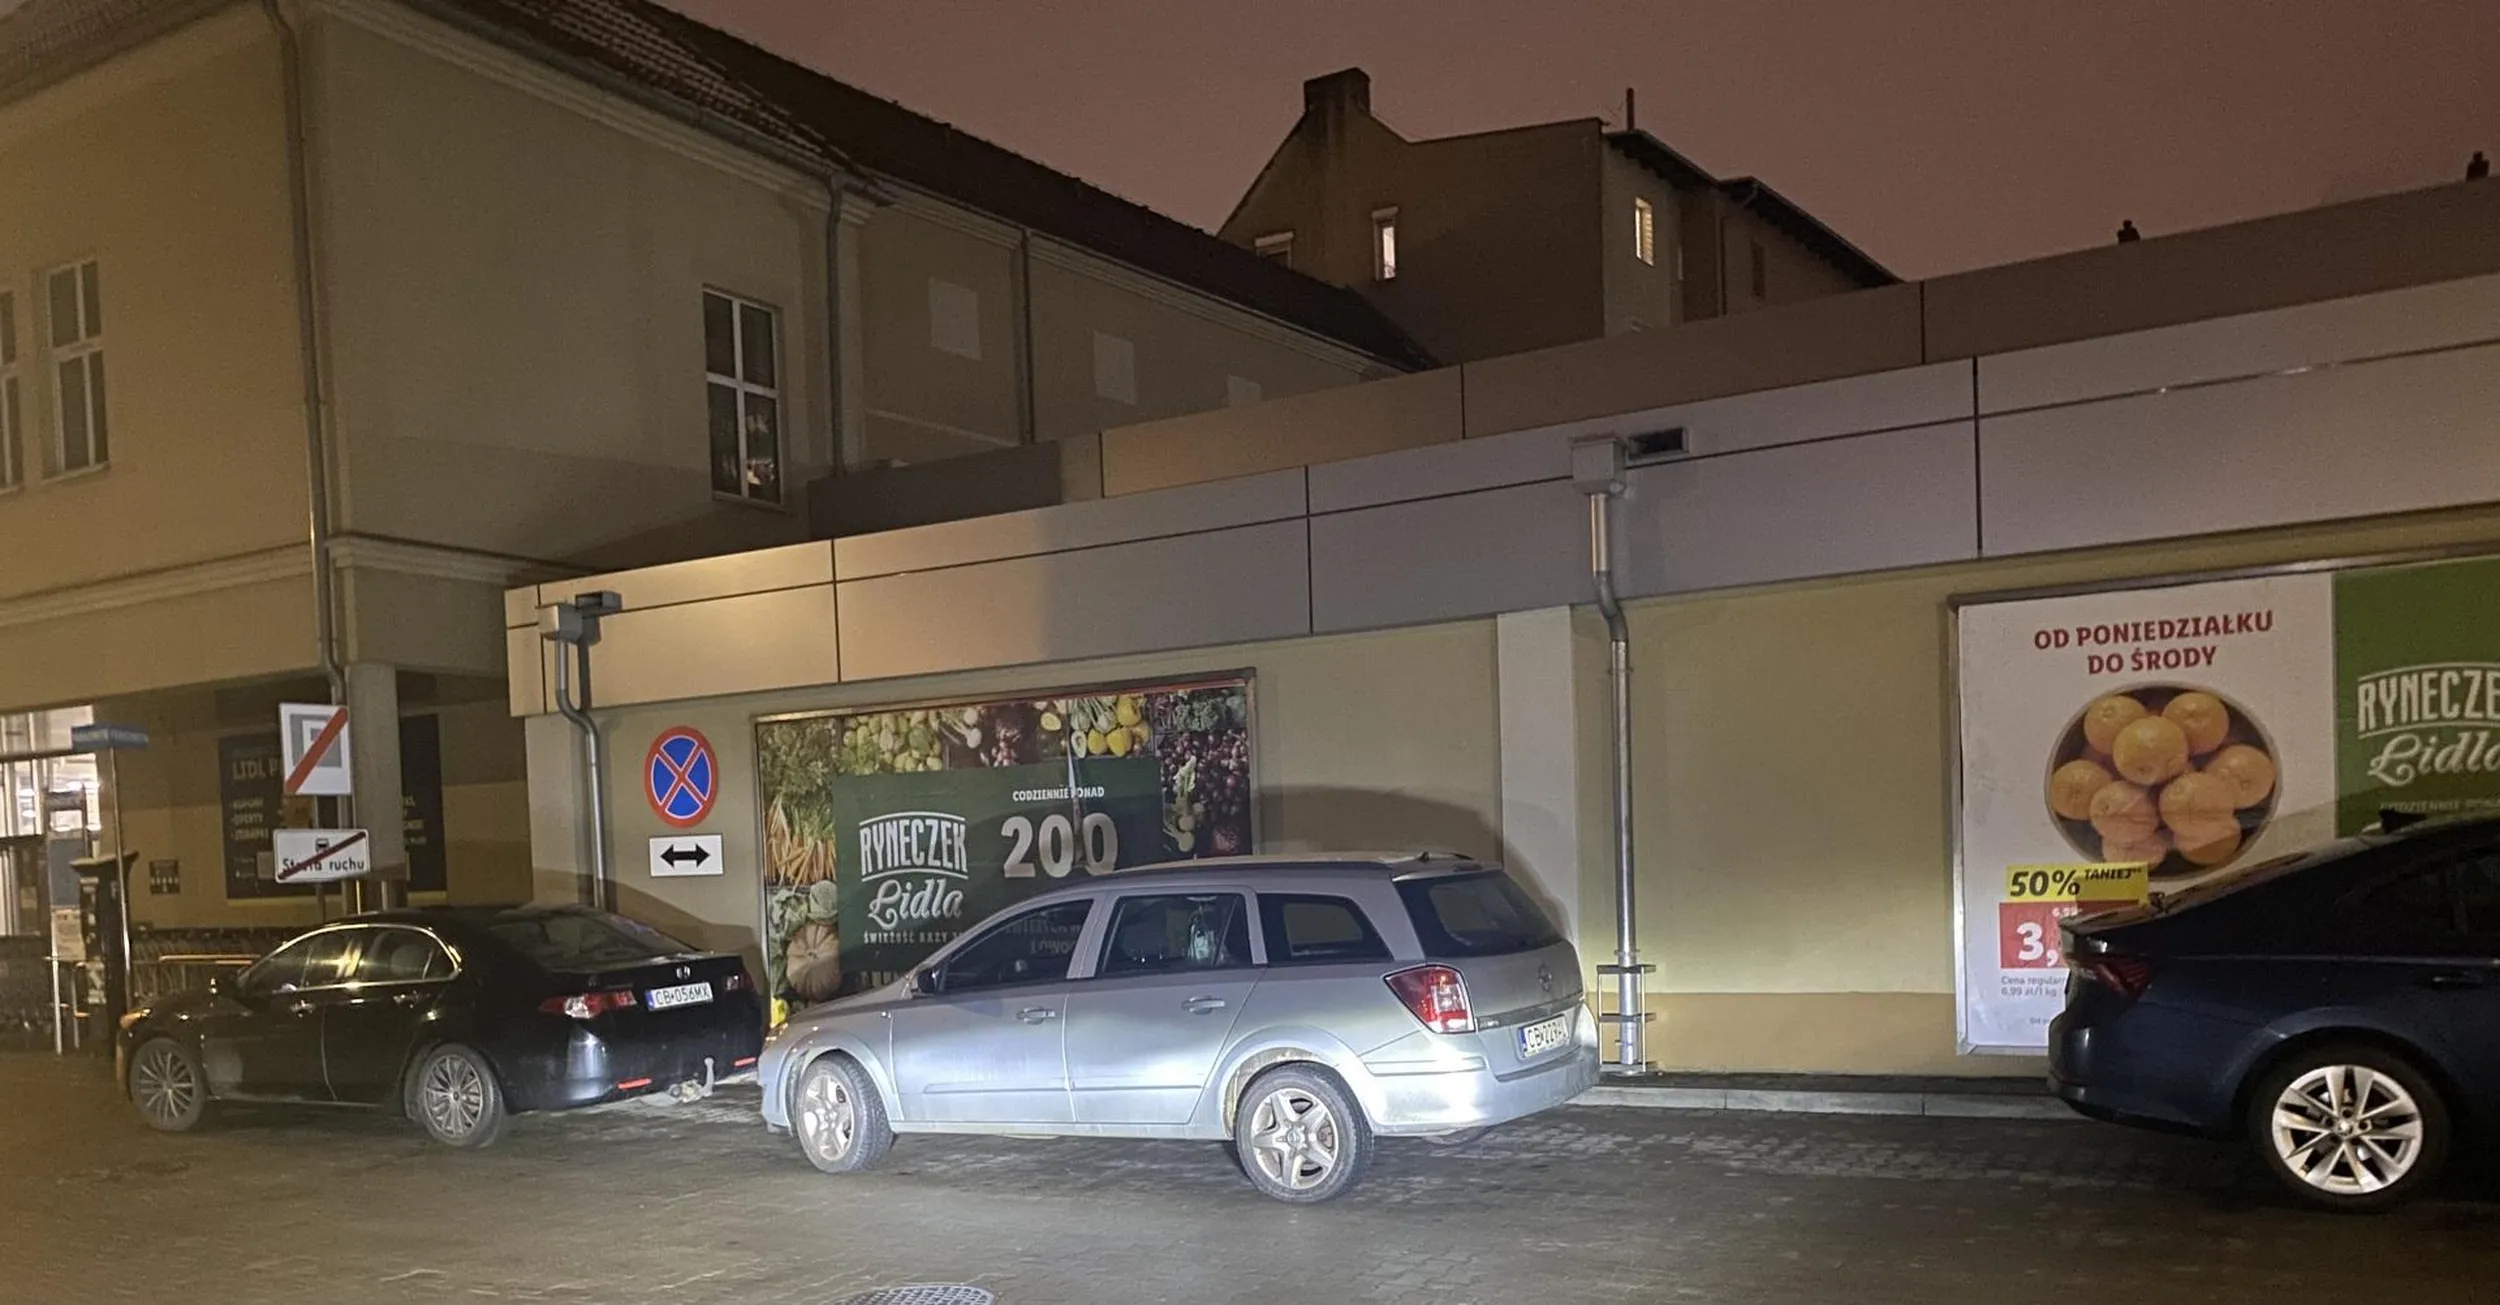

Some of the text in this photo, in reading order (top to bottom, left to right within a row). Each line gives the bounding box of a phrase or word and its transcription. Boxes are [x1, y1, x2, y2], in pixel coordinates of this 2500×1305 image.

[2034, 610, 2273, 650] OD PONIEDZIAŁKU
[2088, 646, 2217, 675] DO ŚRODY
[232, 758, 266, 780] LIDL
[1013, 787, 1069, 802] CODZIENNIE
[860, 819, 968, 876] RYNECZEK
[1001, 812, 1118, 877] 200
[329, 856, 365, 872] ruchu
[2010, 869, 2081, 898] 50%
[868, 878, 963, 930] Lidla
[2001, 975, 2025, 985] Cena
[2045, 987, 2057, 998] kg
